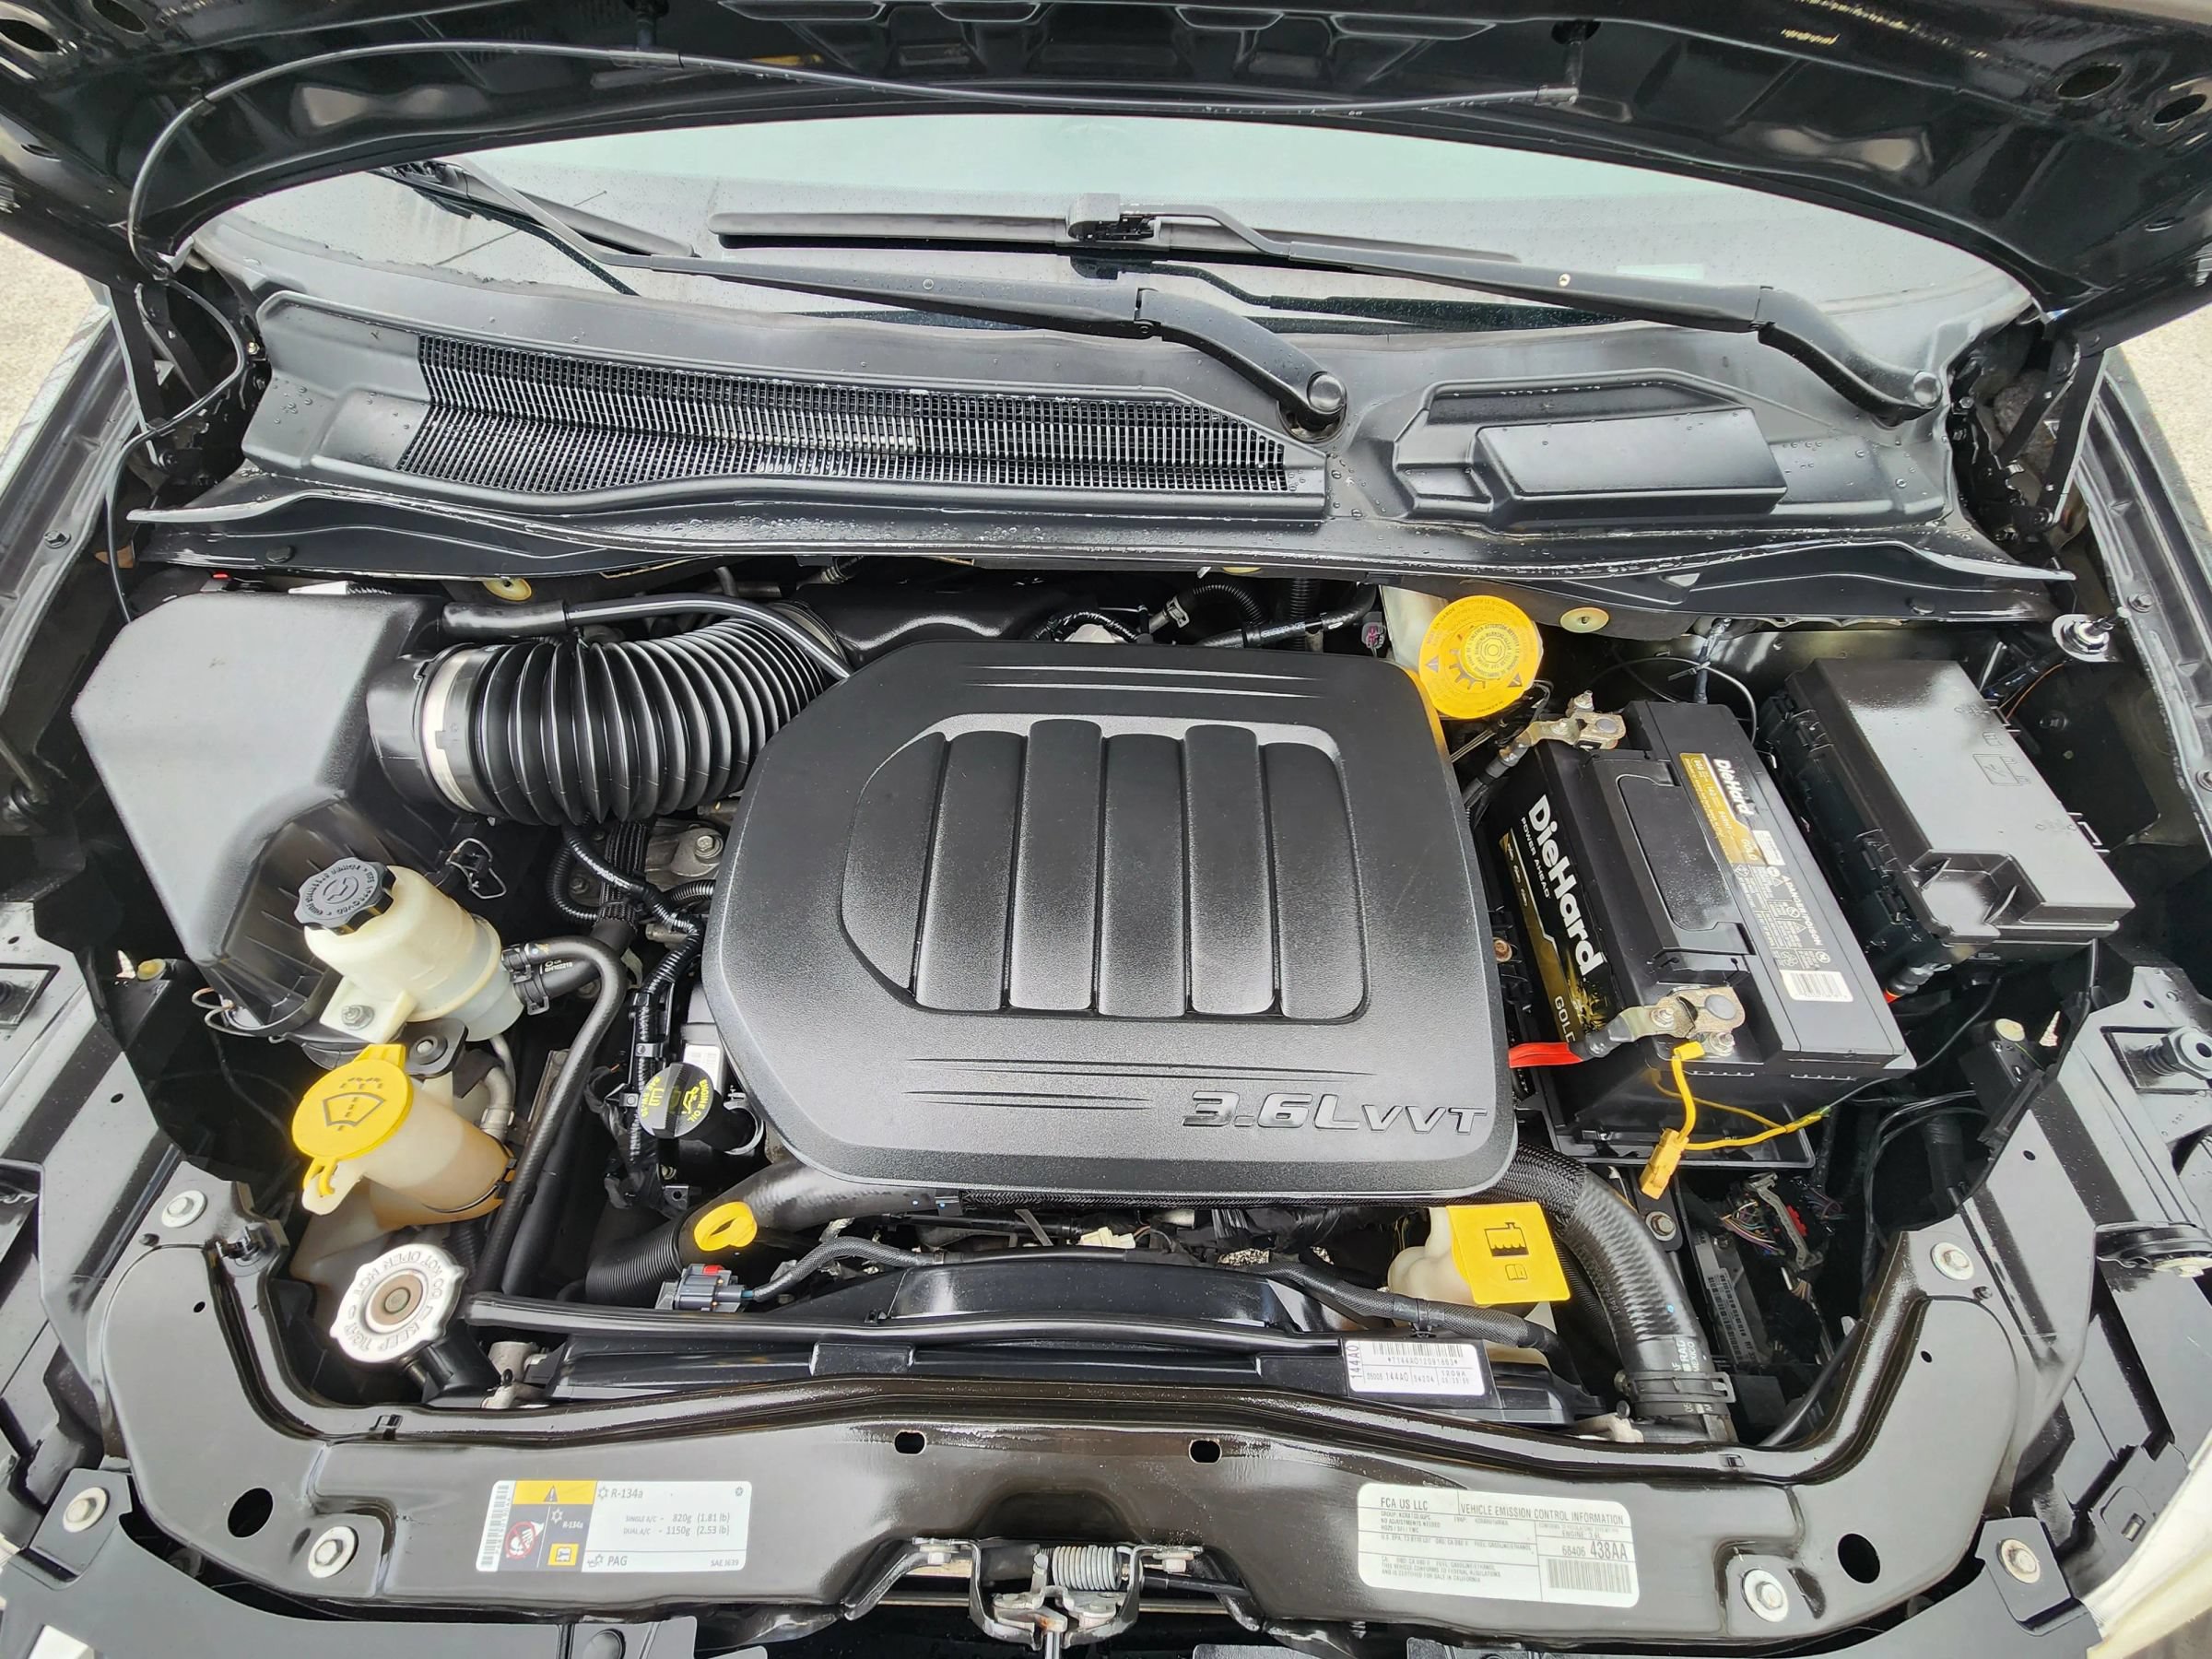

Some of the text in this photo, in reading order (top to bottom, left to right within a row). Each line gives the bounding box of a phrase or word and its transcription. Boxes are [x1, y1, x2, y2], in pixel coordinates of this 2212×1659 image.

[1713, 759, 1754, 815] DieHard
[1521, 817, 1550, 899] POWER AHEAD
[1742, 839, 1759, 861] GOLD
[1528, 794, 1605, 976] DieHard
[687, 1078, 710, 1123] ENGINE OIL
[610, 1488, 643, 1499] R-134a
[1381, 1497, 1429, 1511] FCA US LLC
[625, 1514, 645, 1523] SINGLE
[645, 1514, 657, 1523] A/C
[672, 1513, 692, 1524] 820g
[697, 1512, 717, 1524] (1.81
[719, 1512, 730, 1523] lb)
[1461, 1503, 1624, 1525] VEHICLE EMISSION CONTROL INFORMATION
[562, 1521, 583, 1529] R-134a
[641, 1527, 652, 1535] A/C
[665, 1525, 691, 1536] 1150g
[696, 1525, 717, 1536] (2.53
[719, 1524, 730, 1535] lb)
[1561, 1540, 1628, 1560] 68406 438AA
[607, 1555, 628, 1566] PAG
[710, 1559, 724, 1567] SAE
